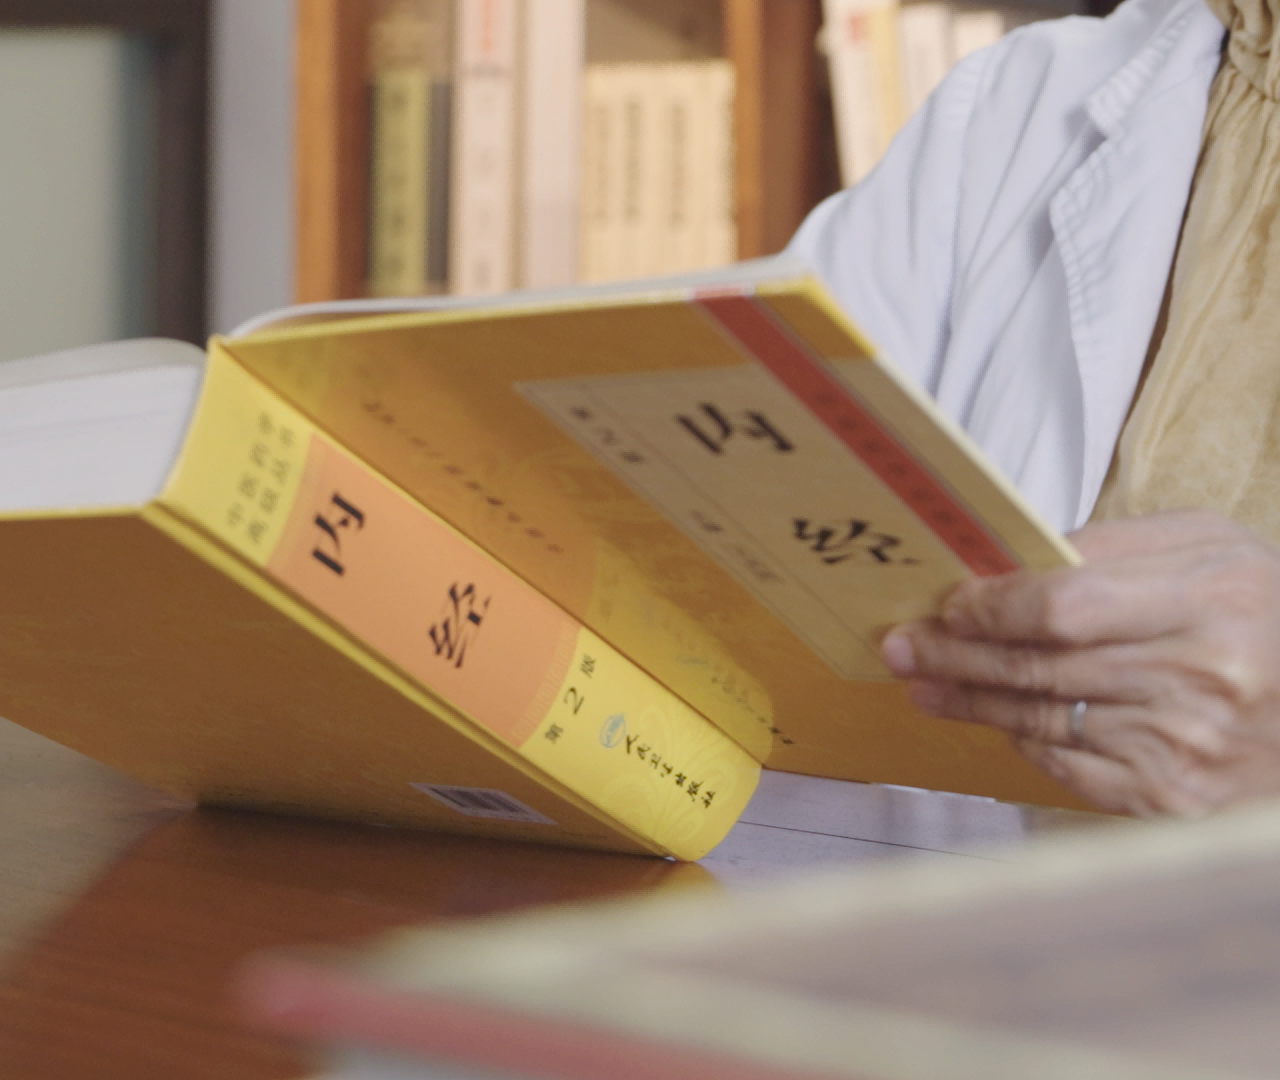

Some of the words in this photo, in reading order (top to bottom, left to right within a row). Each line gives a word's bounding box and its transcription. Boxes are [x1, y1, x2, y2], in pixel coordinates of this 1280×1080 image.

[312, 488, 492, 668] 内经
[544, 653, 597, 745] 第2版
[624, 733, 717, 810] 人民卫生出版社
